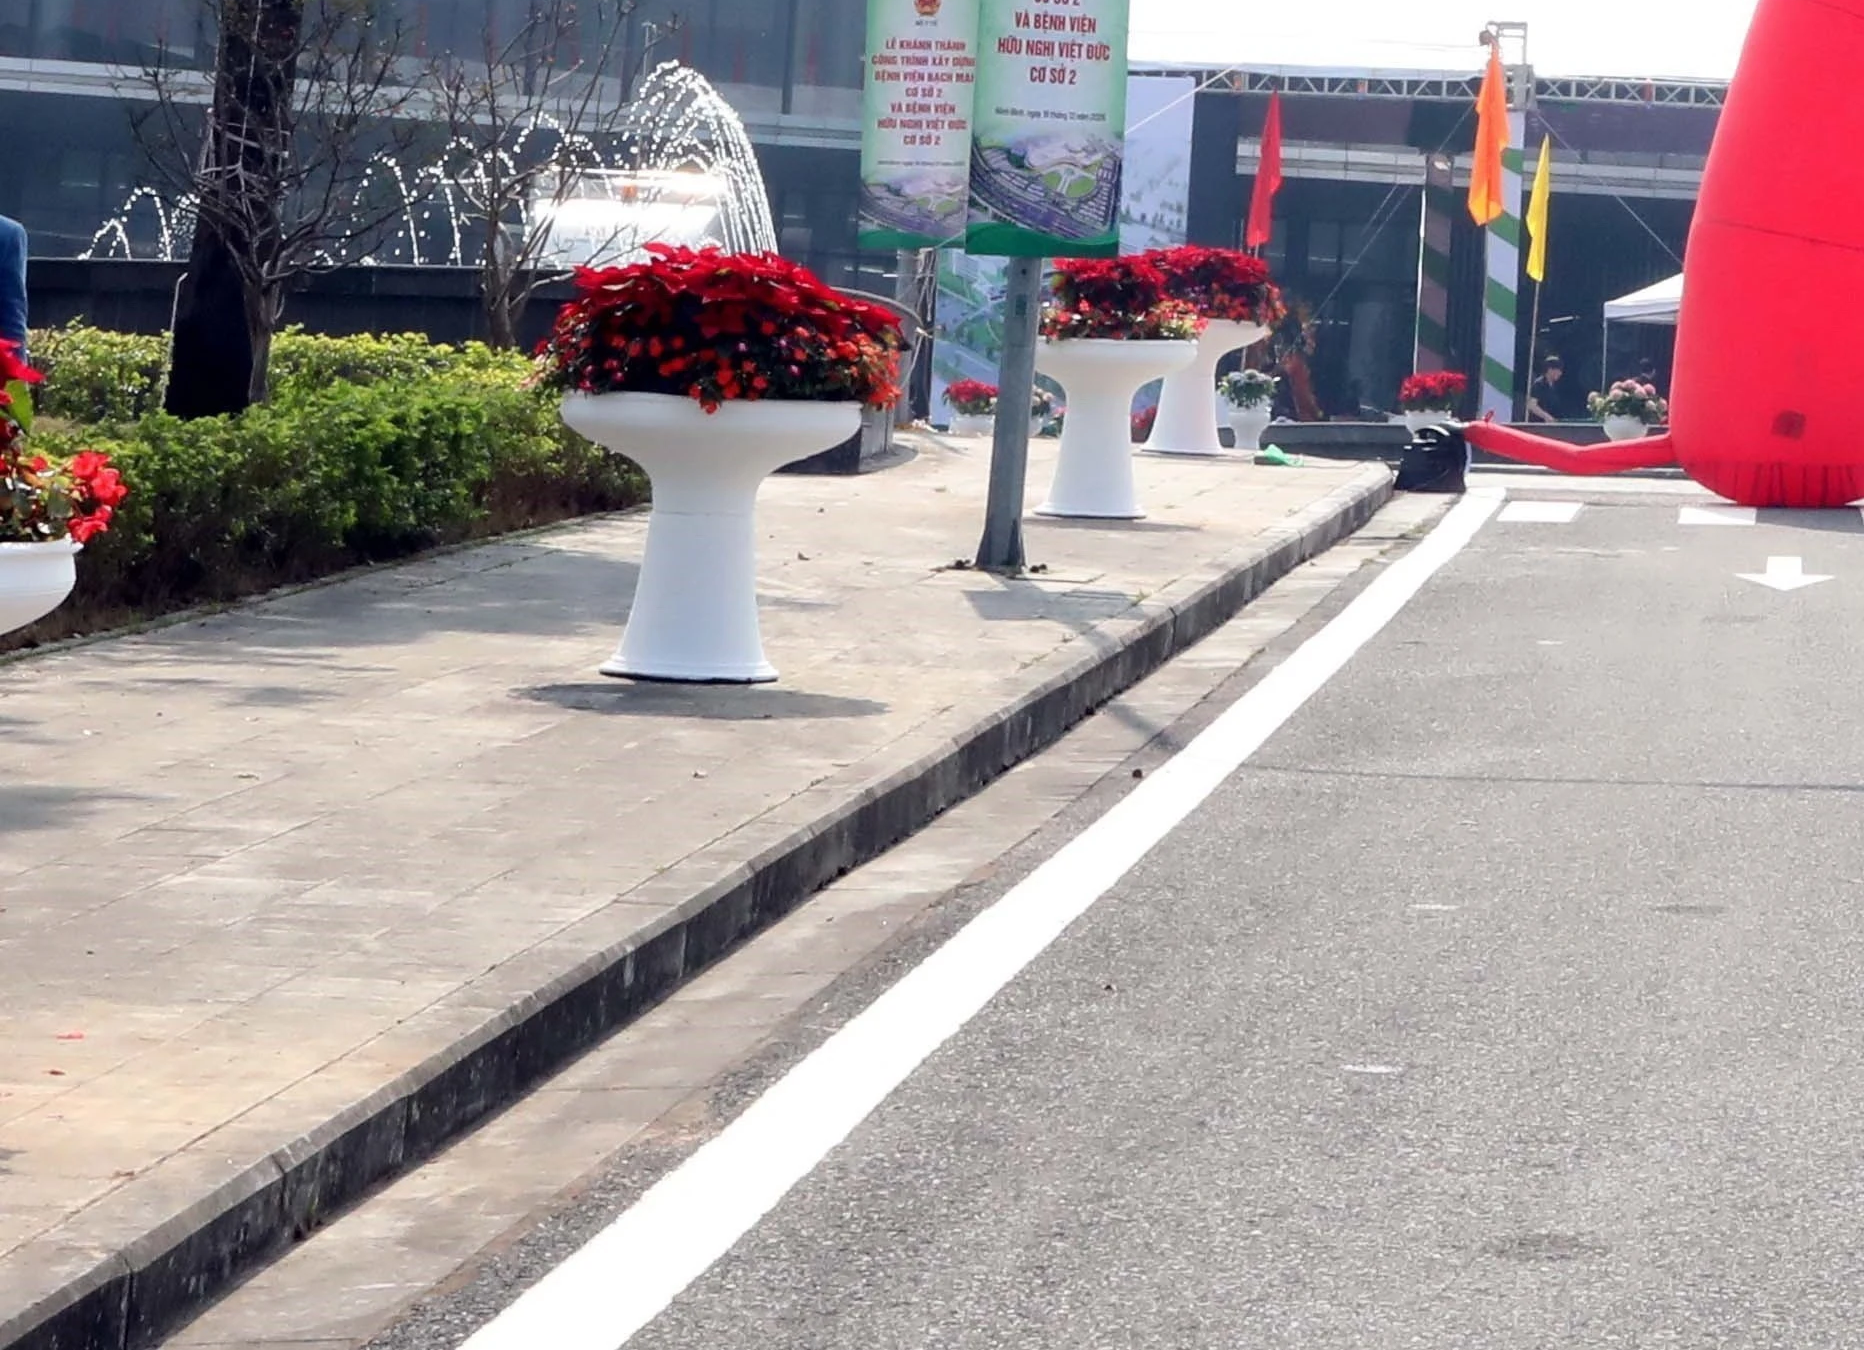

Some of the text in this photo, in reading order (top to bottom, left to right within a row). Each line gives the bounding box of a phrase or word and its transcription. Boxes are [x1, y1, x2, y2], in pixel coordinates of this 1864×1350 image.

[1015, 9, 1030, 29] VÀ
[1030, 63, 1077, 85] CƠ SỞ 2
